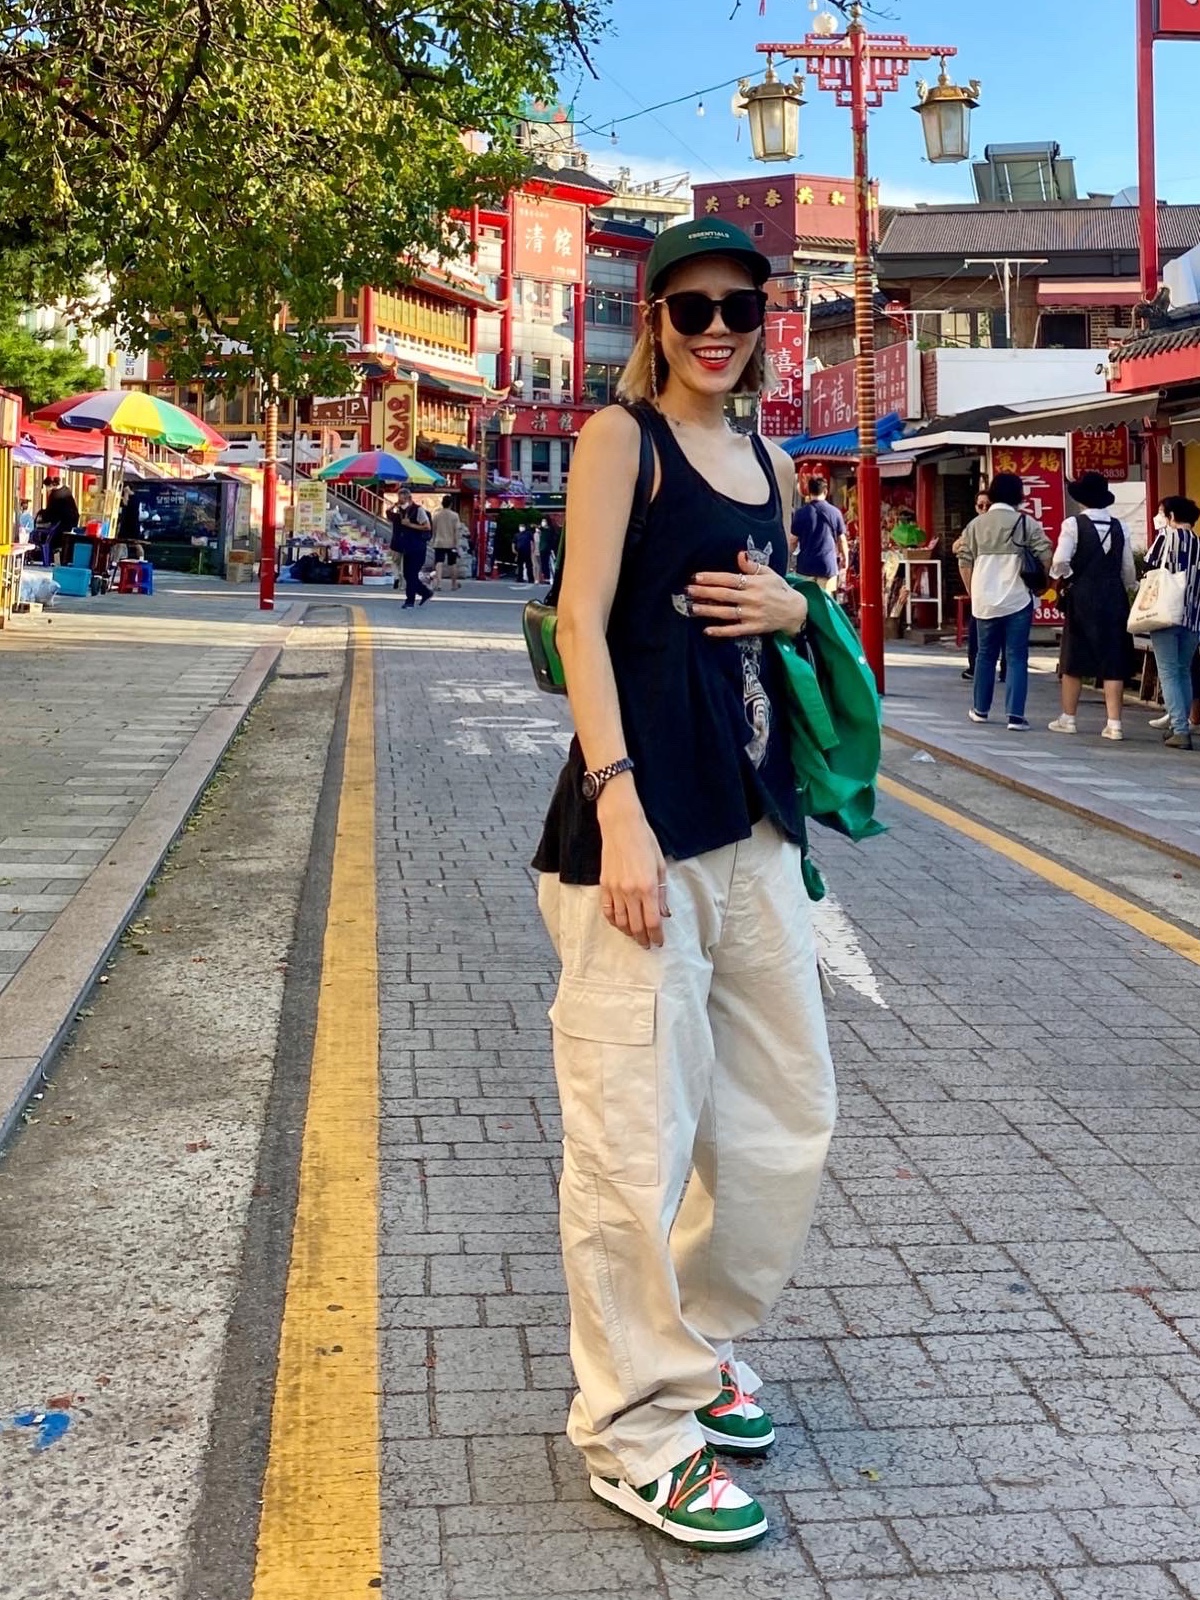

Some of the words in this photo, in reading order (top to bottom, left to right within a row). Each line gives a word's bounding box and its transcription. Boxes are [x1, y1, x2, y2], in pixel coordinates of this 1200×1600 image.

[688, 231, 730, 239] ESSENTIALS
[351, 402, 360, 414] P
[1075, 439, 1123, 456] 주차장
